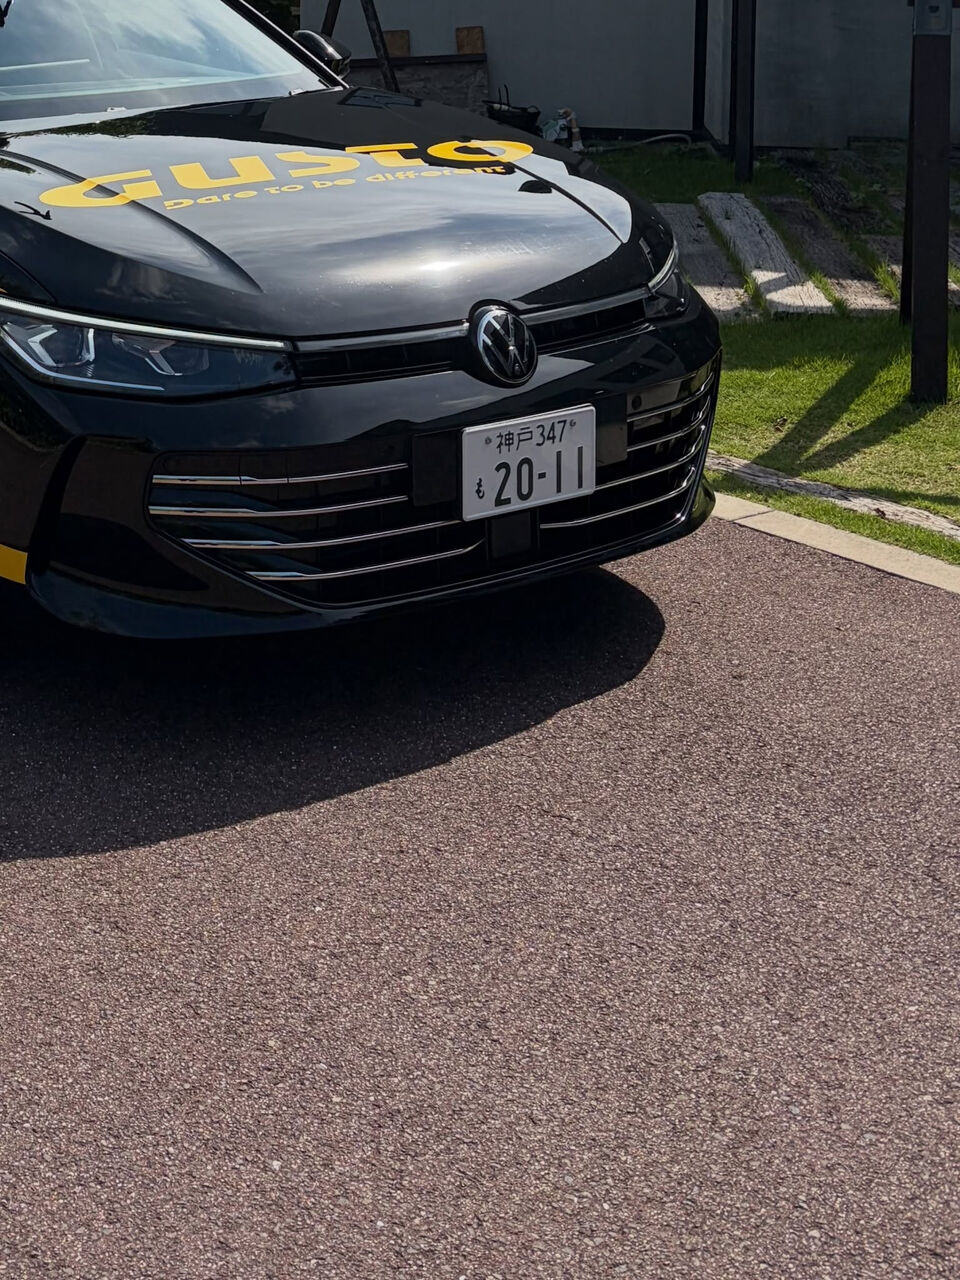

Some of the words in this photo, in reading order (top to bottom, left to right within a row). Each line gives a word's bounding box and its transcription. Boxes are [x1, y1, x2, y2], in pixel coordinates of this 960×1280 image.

[39, 140, 534, 207] GUSTO
[163, 190, 258, 210] Dare
[263, 184, 304, 194] to
[312, 178, 356, 189] be
[365, 166, 506, 183] different
[495, 426, 534, 454] 神戸
[535, 420, 568, 447] 347
[475, 478, 485, 500] も
[494, 446, 584, 508] 20-11
